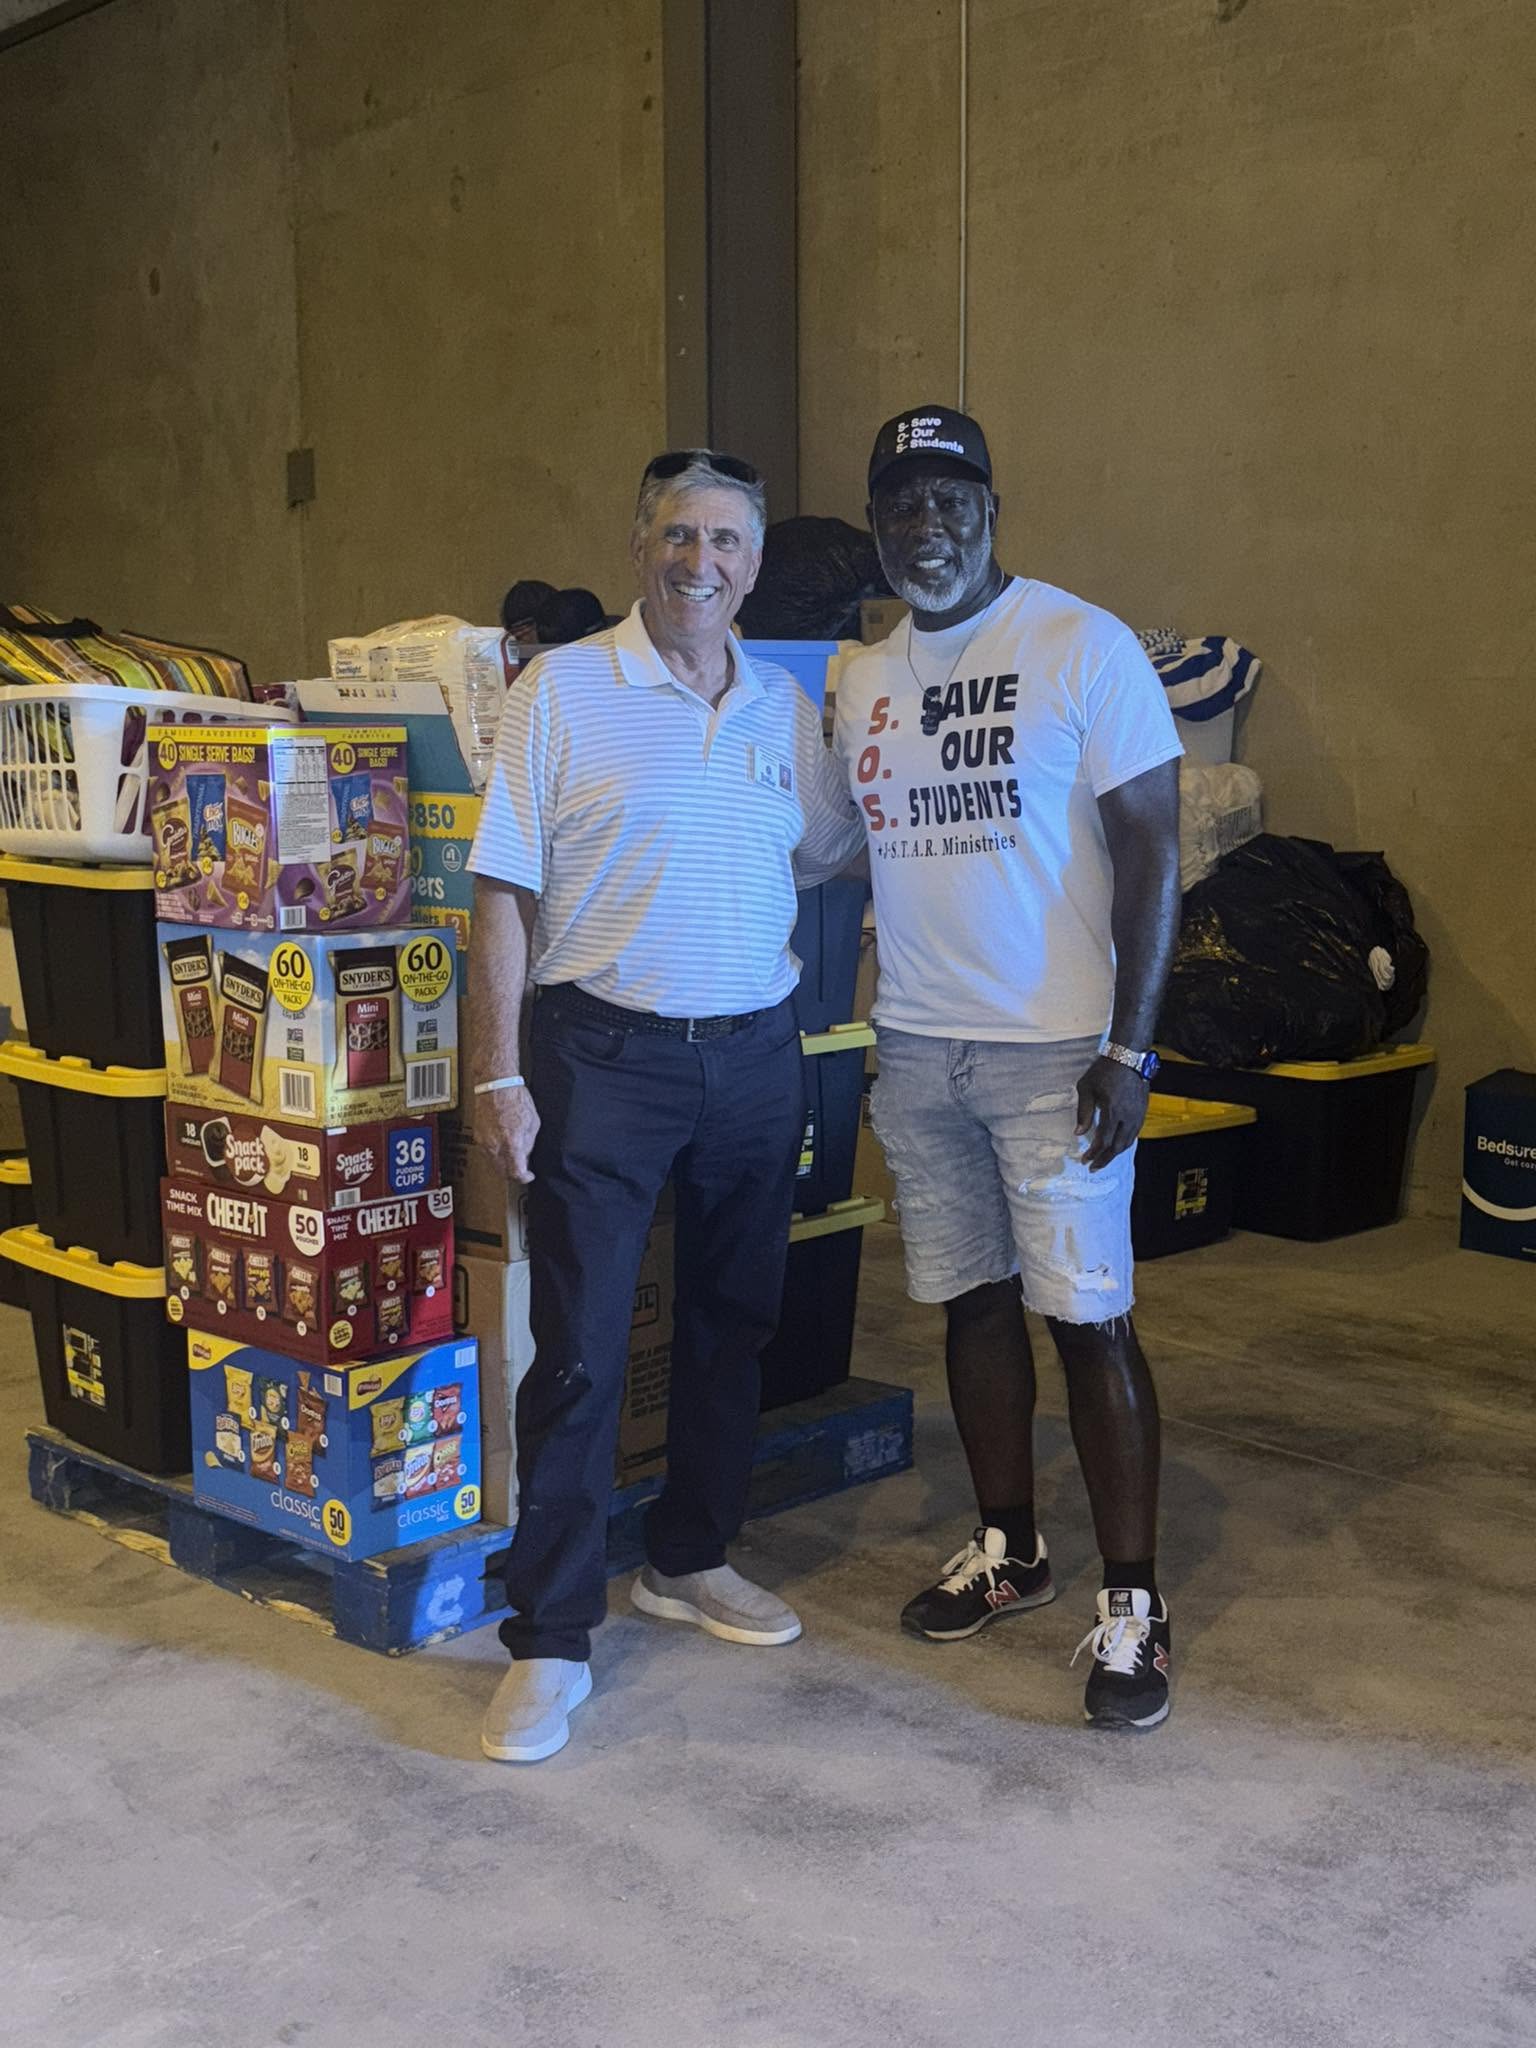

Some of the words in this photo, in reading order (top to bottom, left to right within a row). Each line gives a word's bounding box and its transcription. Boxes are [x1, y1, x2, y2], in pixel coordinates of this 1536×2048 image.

[911, 418, 941, 427] Save
[911, 428, 935, 438] Our
[910, 438, 964, 454] Students
[868, 696, 899, 735] S.
[922, 673, 1019, 723] SAVE
[200, 730, 257, 738] FAVORITES
[160, 743, 176, 762] 40
[179, 745, 204, 761] SINGLE
[206, 745, 230, 762] SERVE
[232, 746, 255, 763] BAGS!
[333, 748, 353, 766] 40
[357, 747, 377, 757] SINGLE
[380, 747, 398, 757] SERVE
[857, 745, 892, 783] O.
[940, 725, 1015, 771] OUR
[862, 793, 898, 831] S.
[909, 778, 1022, 827] STUDENTS
[942, 831, 1016, 856] Ministries
[276, 950, 305, 978] 60
[407, 942, 443, 972] 60
[173, 958, 207, 976] SNYDER'S
[272, 978, 311, 992] ON-THE-GO
[342, 969, 391, 985] SNYDER'S
[402, 970, 448, 985] ON-THE-GO
[187, 991, 202, 1001] Mini
[225, 977, 263, 1003] SNYDER'S
[414, 987, 438, 998] PACKS
[283, 994, 303, 1005] PACKS
[357, 1002, 379, 1014] Mini
[232, 1011, 249, 1026] Mini
[185, 1123, 196, 1138] 18
[225, 1134, 265, 1159] Snack
[298, 1147, 309, 1162] 18
[395, 1137, 425, 1166] 36
[1477, 1135, 1536, 1159] Bedsure
[235, 1155, 265, 1176] pack
[336, 1148, 374, 1172] Snack
[1504, 1158, 1518, 1167] Get
[344, 1161, 374, 1181] pack
[395, 1172, 424, 1187] CUPS
[169, 1188, 198, 1204] SNACK
[433, 1192, 450, 1207] 50
[166, 1200, 185, 1213] TIME
[187, 1205, 203, 1217] MIX
[296, 1214, 318, 1237] 50
[326, 1214, 351, 1227] SNACK
[331, 1224, 349, 1233] TIME
[333, 1232, 347, 1241] MIX
[301, 1404, 322, 1421] Doritos
[270, 1488, 321, 1523] classic
[460, 1490, 475, 1509] 50
[329, 1507, 345, 1531] 50
[397, 1499, 449, 1528] classic
[310, 1522, 321, 1531] MIX
[331, 1529, 345, 1540] BAGS
